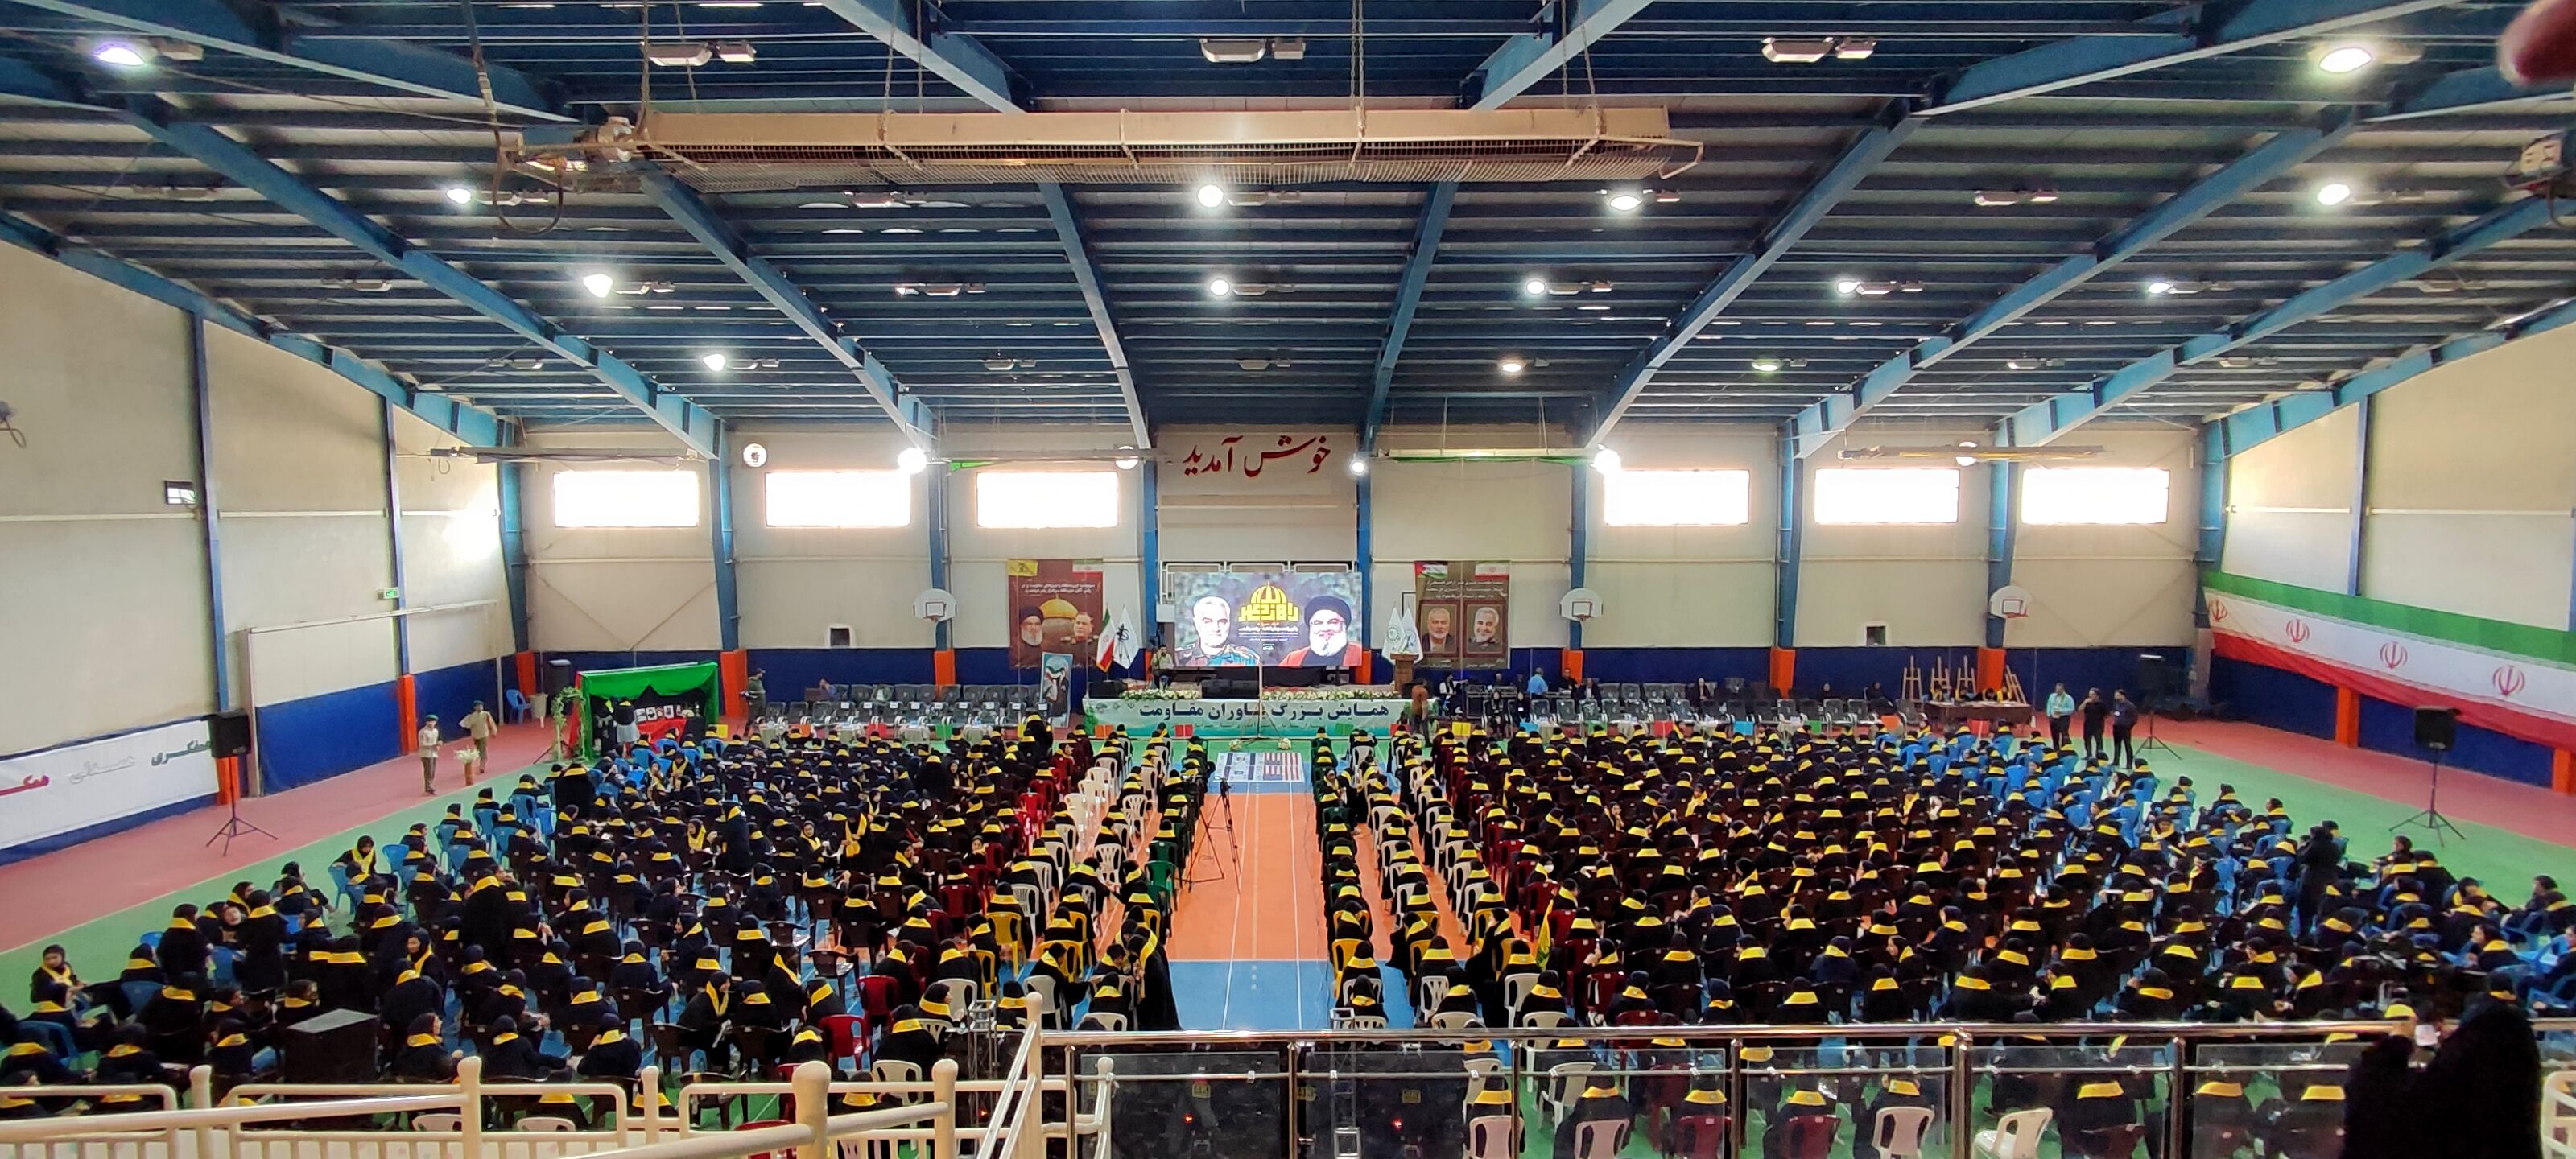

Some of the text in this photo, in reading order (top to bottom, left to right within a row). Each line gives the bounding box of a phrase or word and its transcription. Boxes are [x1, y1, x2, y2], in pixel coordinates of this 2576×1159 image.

[1182, 435, 1331, 477] خوش آمدید
[1139, 702, 1204, 720] مقاومت
[1271, 703, 1323, 720] بزرگ
[1327, 703, 1389, 720] همایش
